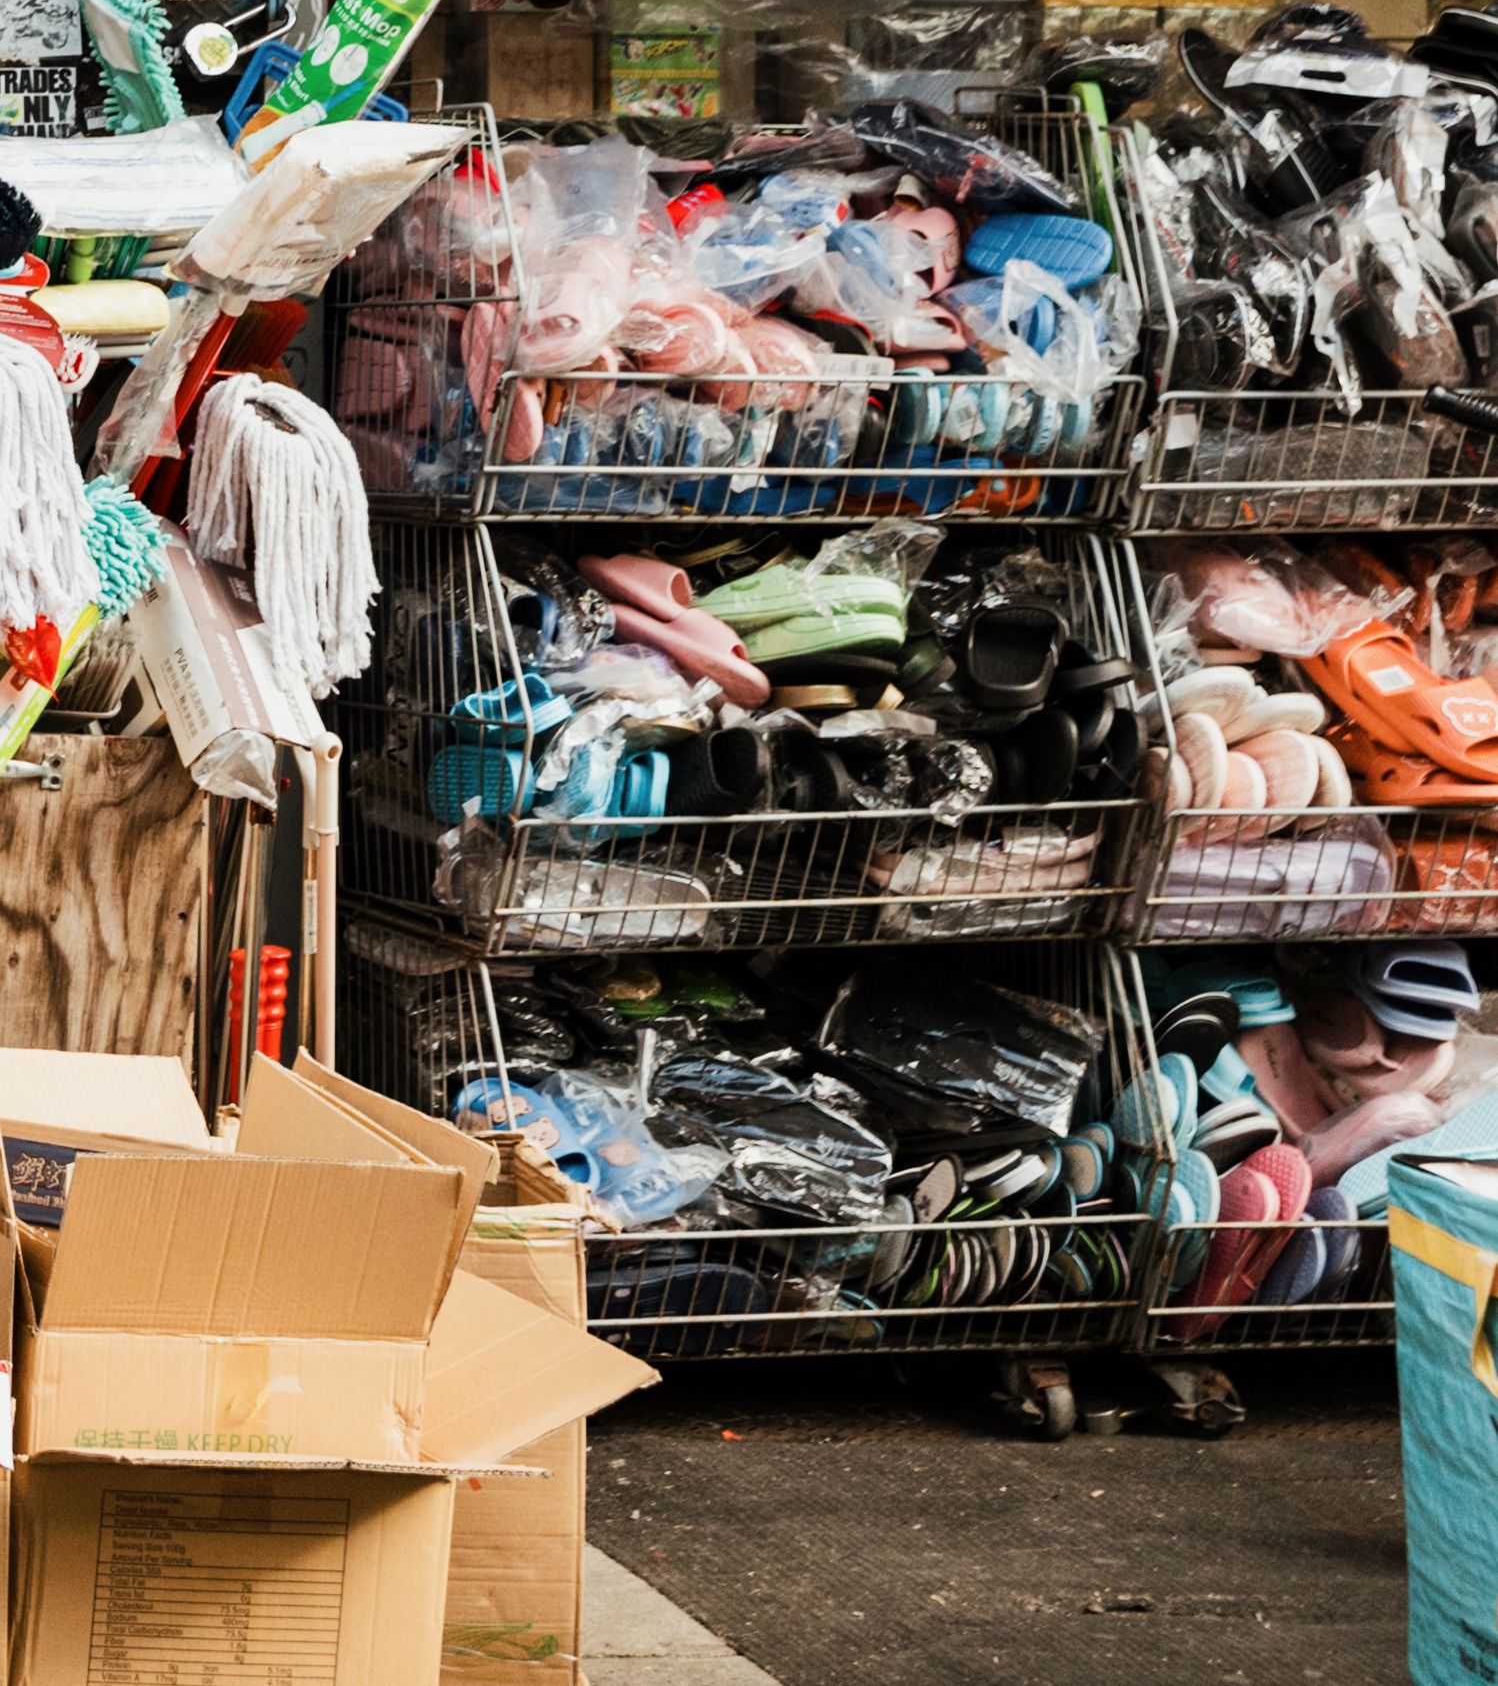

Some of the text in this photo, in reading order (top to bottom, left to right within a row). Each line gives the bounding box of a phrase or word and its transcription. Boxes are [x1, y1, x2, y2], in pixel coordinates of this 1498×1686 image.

[360, 5, 403, 39] Mop
[23, 95, 72, 123] NLY
[171, 647, 192, 673] PVA
[248, 1434, 293, 1454] DRY
[112, 1529, 172, 1540] Nutrition Facts
[112, 1541, 143, 1552] Serving
[145, 1542, 164, 1551] Size
[112, 1553, 193, 1567] Amount Per Serving
[110, 1577, 130, 1586] Total
[132, 1578, 146, 1587] Fat
[109, 1589, 132, 1598] Trans
[107, 1601, 153, 1611] Cholesterol
[106, 1613, 138, 1623] Sodium
[106, 1625, 126, 1634] Total
[104, 1637, 125, 1646] Fiber
[103, 1649, 128, 1658] Sugar
[102, 1661, 132, 1670] Protein
[101, 1672, 132, 1682] Vitamin
